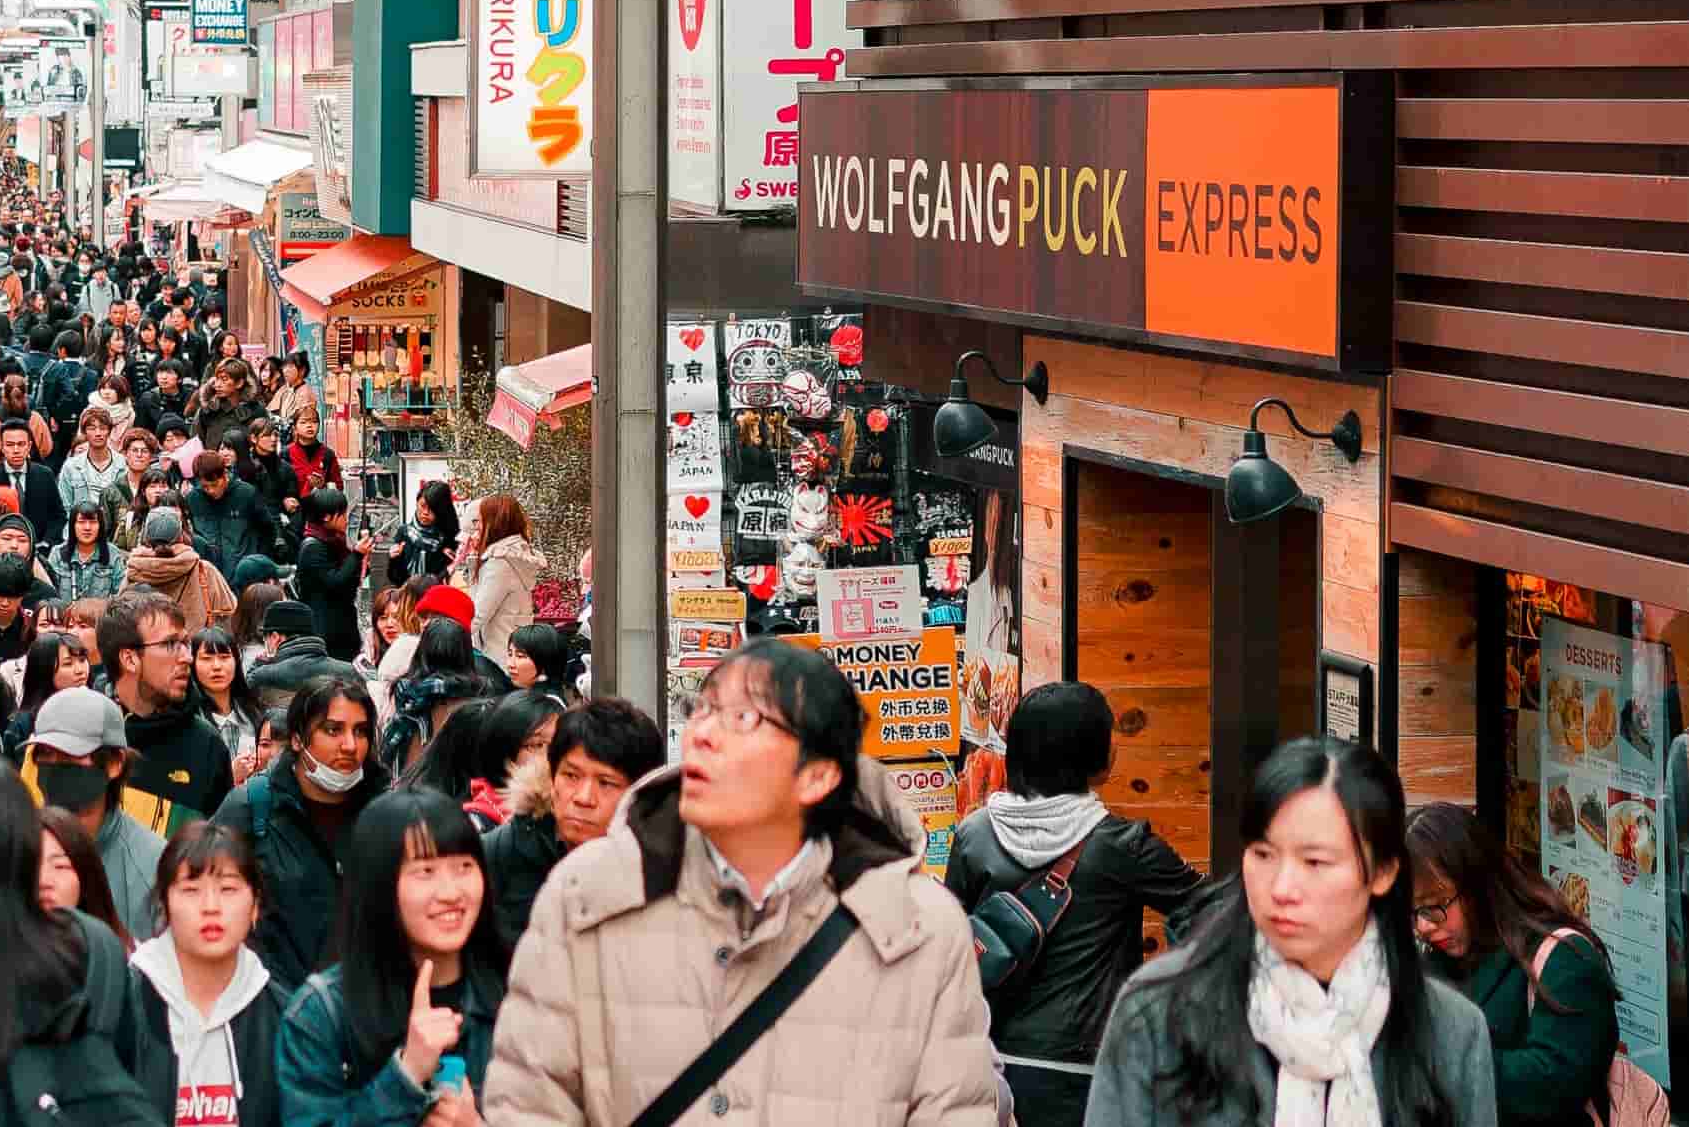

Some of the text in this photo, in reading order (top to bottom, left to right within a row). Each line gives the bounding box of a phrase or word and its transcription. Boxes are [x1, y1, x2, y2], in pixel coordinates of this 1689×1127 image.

[1157, 180, 1323, 265] EXPRESS
[351, 294, 406, 308] SOCKS
[735, 323, 782, 338] TOKYO
[836, 643, 922, 665] MONEY
[1565, 643, 1623, 675] DESSERTS
